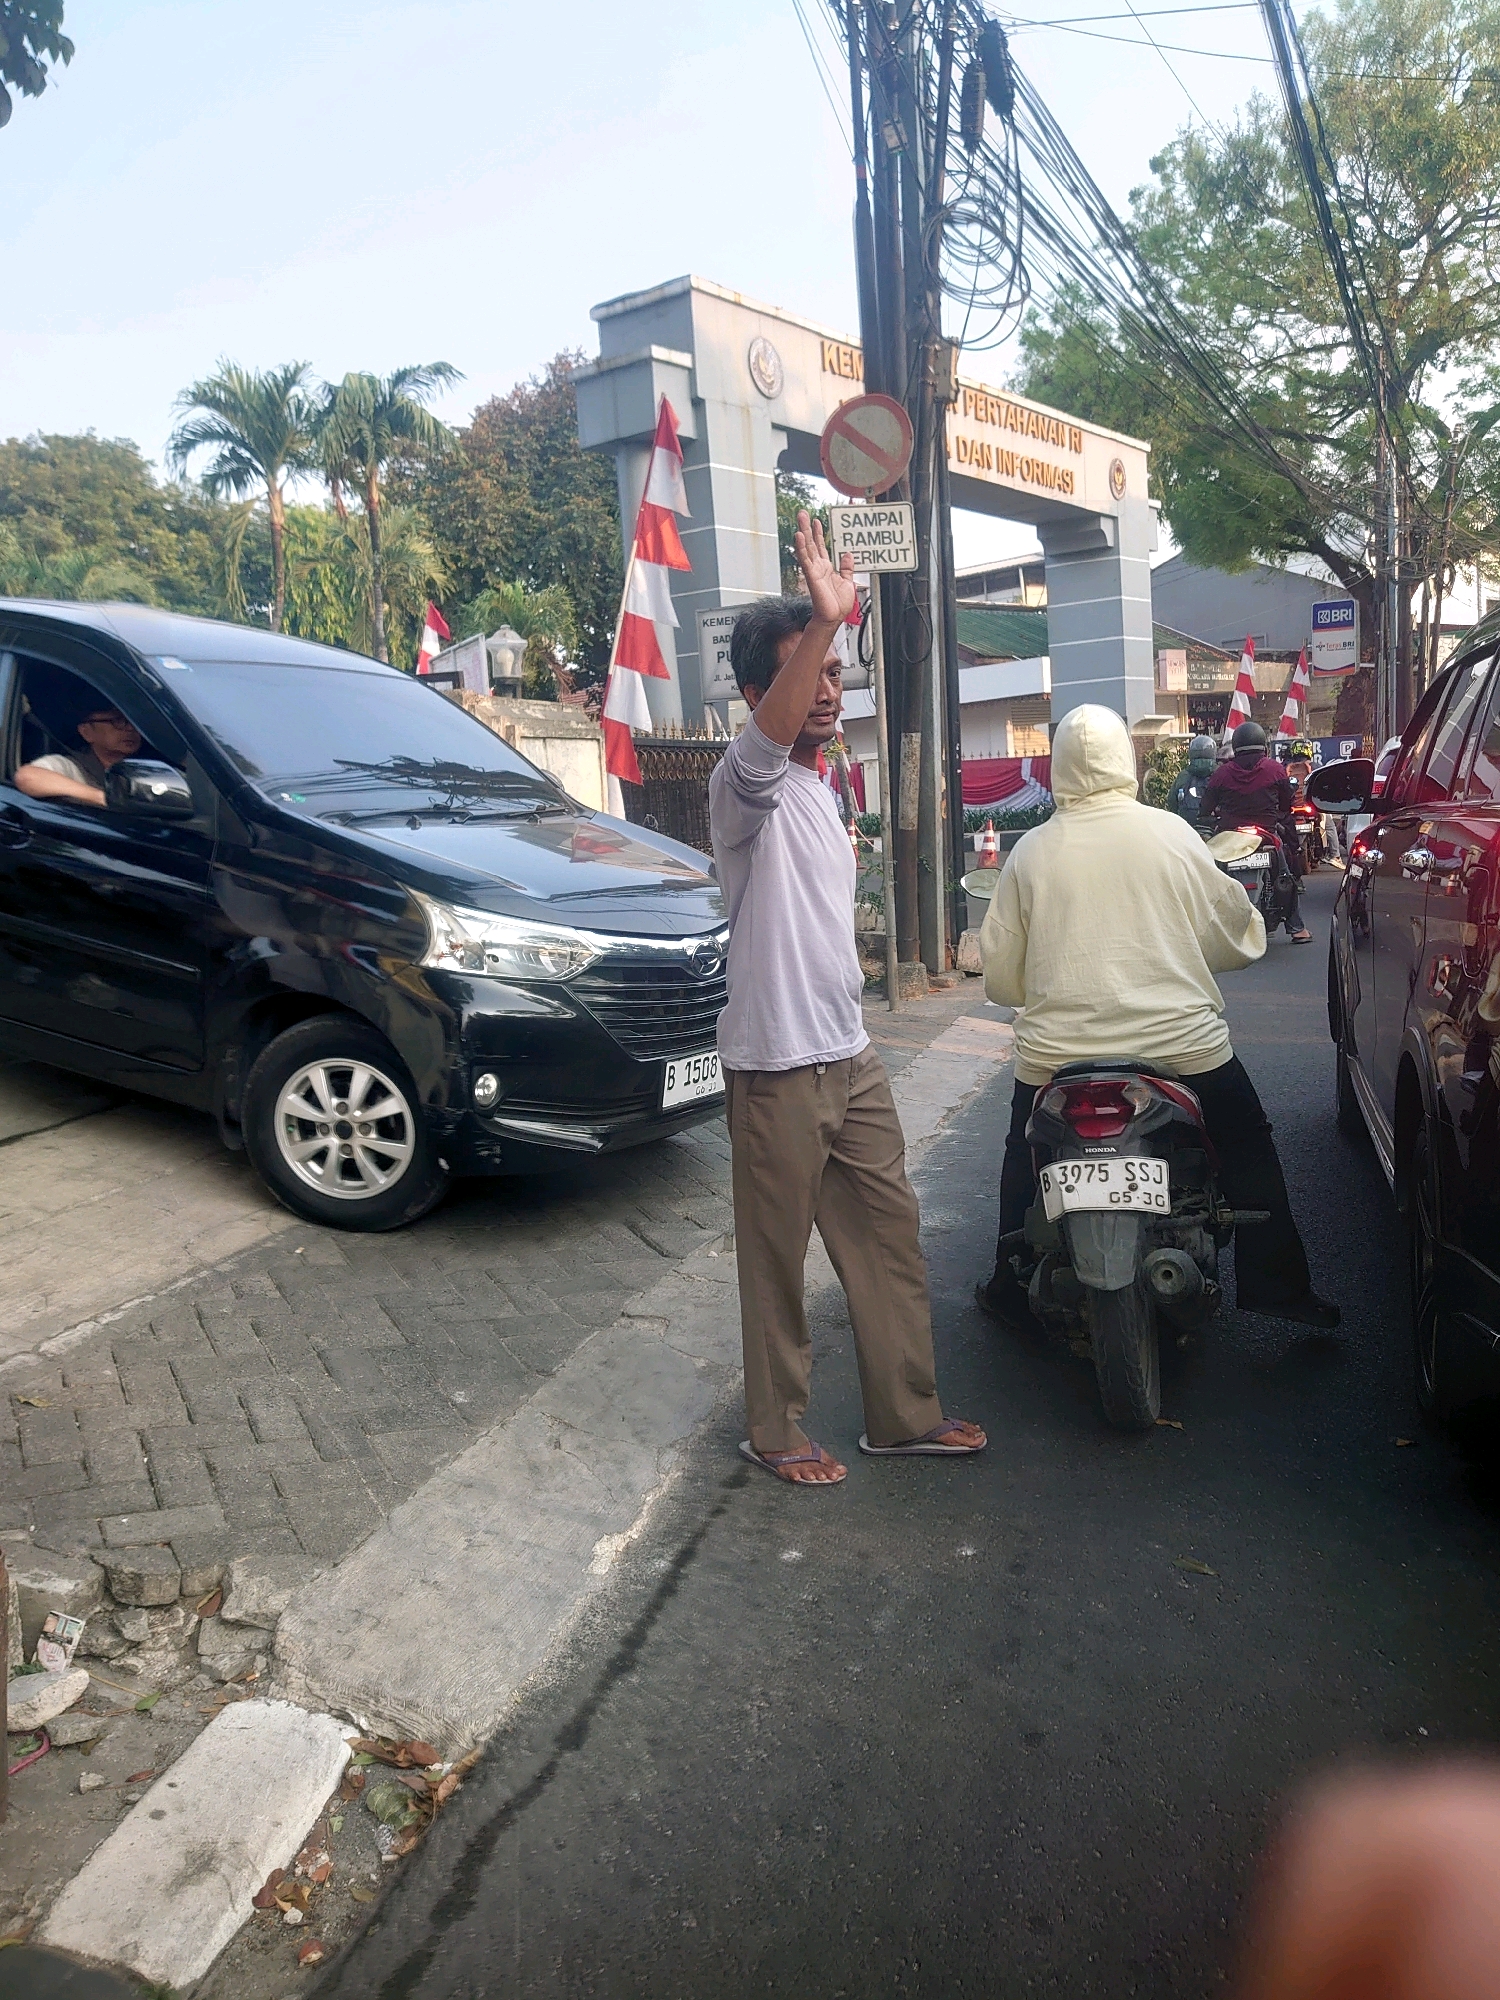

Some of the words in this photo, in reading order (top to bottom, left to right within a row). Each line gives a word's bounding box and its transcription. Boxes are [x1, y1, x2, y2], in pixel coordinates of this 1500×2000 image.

[963, 389, 1067, 449] PERTAHANAN
[1068, 426, 1082, 455] RI
[955, 435, 993, 471] DAN
[995, 446, 1075, 495] INFORMASI
[841, 511, 903, 529] SAMPAI
[843, 530, 904, 547] RAMBU
[1331, 608, 1353, 622] BRI
[667, 1065, 676, 1091] B
[683, 1055, 718, 1087] 1508
[1042, 1172, 1052, 1193] B
[1058, 1163, 1110, 1185] 3975
[1124, 1162, 1163, 1184] SSJ
